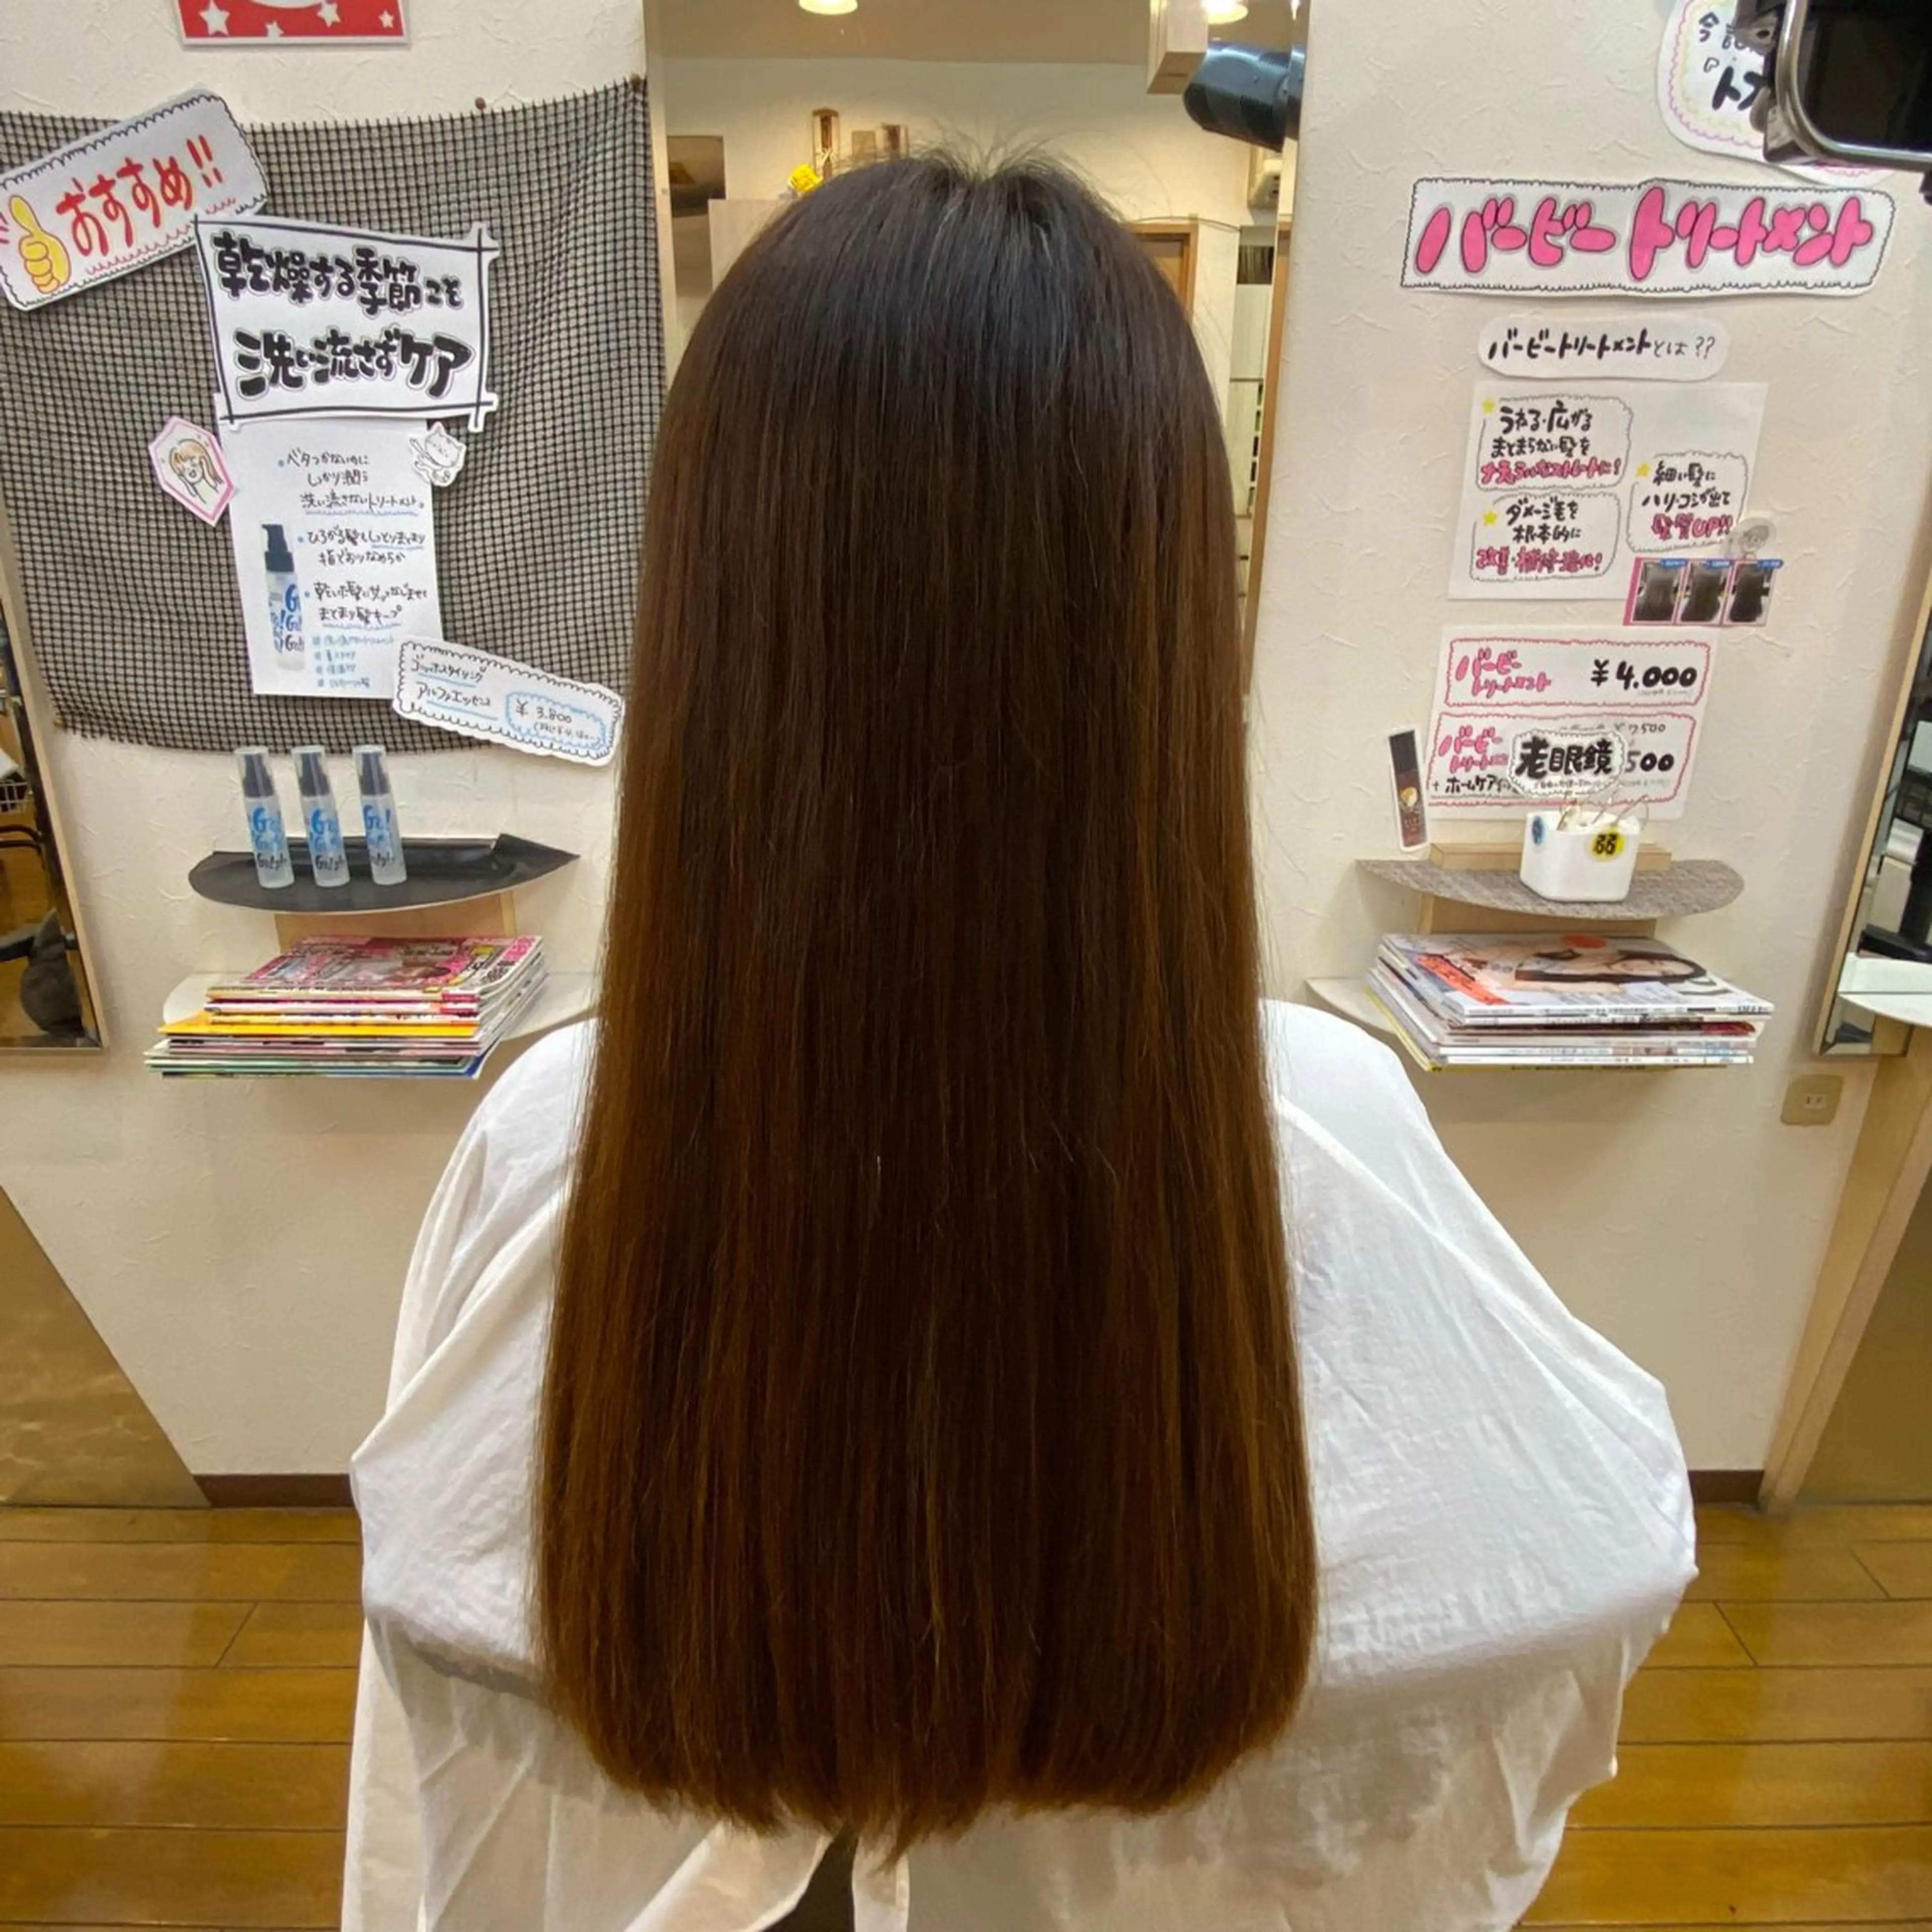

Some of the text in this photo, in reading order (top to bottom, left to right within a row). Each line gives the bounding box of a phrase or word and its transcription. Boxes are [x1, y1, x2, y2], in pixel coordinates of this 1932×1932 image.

[213, 231, 463, 315] 乾燥する季節こそ
[235, 328, 474, 397] 洗い流さずケア
[1512, 524, 1581, 544] 根本的に
[1515, 737, 1613, 779] 老眼鏡
